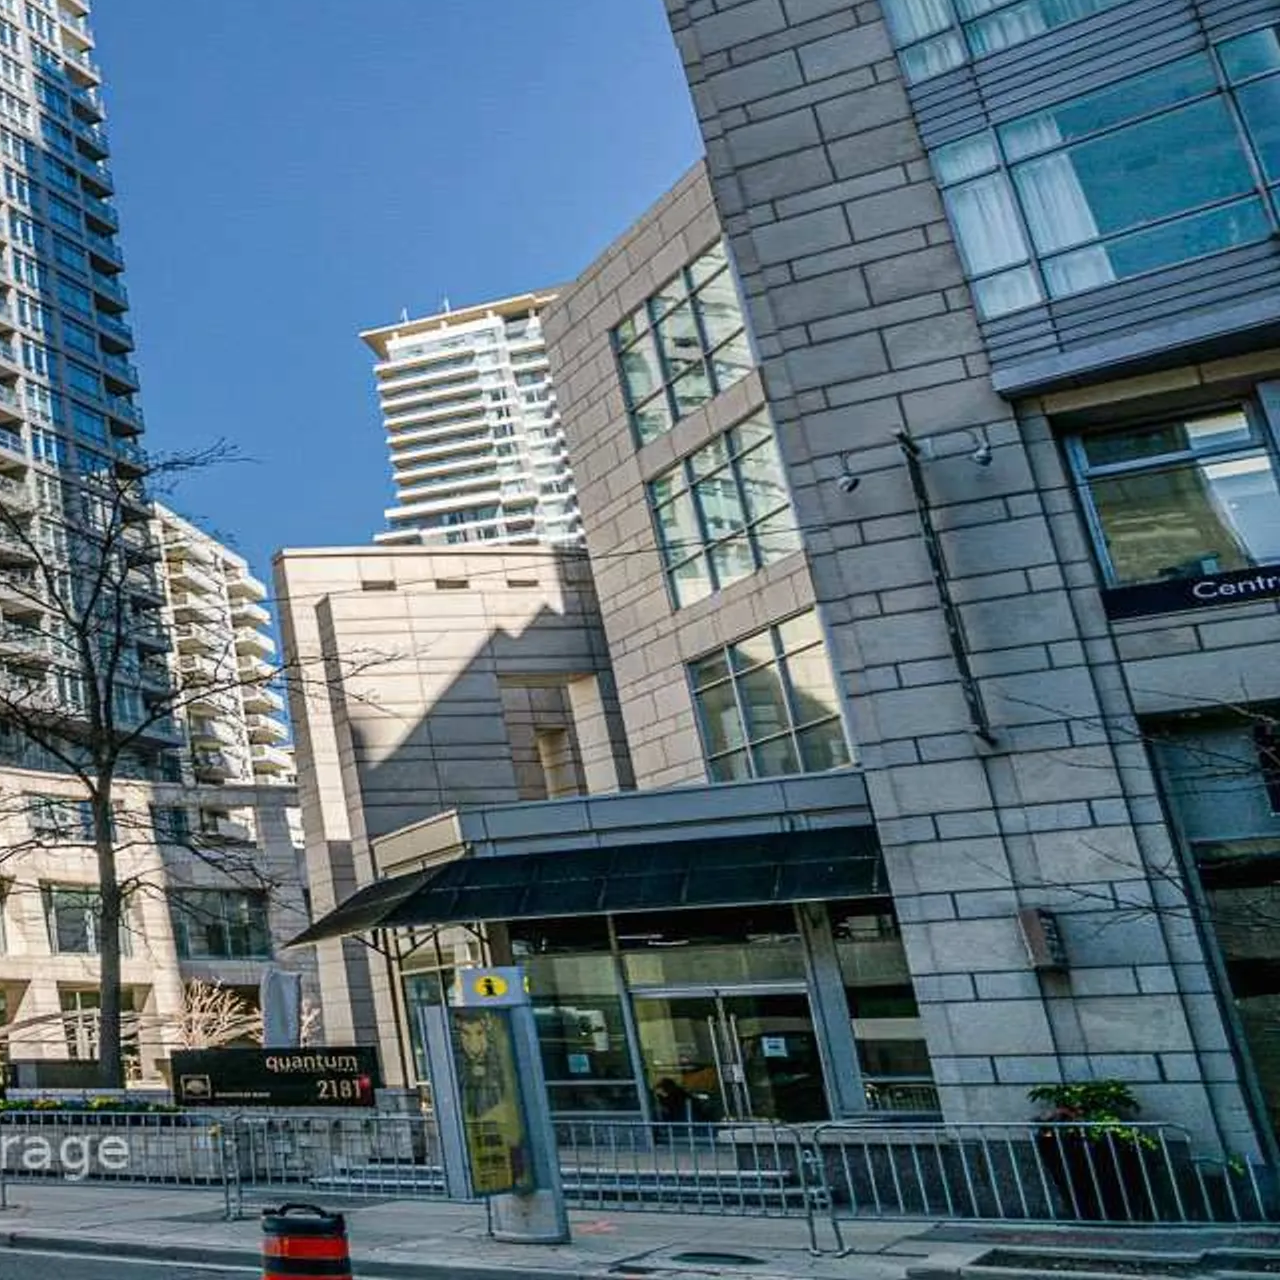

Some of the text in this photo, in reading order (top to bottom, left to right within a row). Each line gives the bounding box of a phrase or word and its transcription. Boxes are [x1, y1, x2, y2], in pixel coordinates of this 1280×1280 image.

[1192, 576, 1280, 598] Centr
[266, 1055, 358, 1072] quantum
[316, 1078, 361, 1099] 2181
